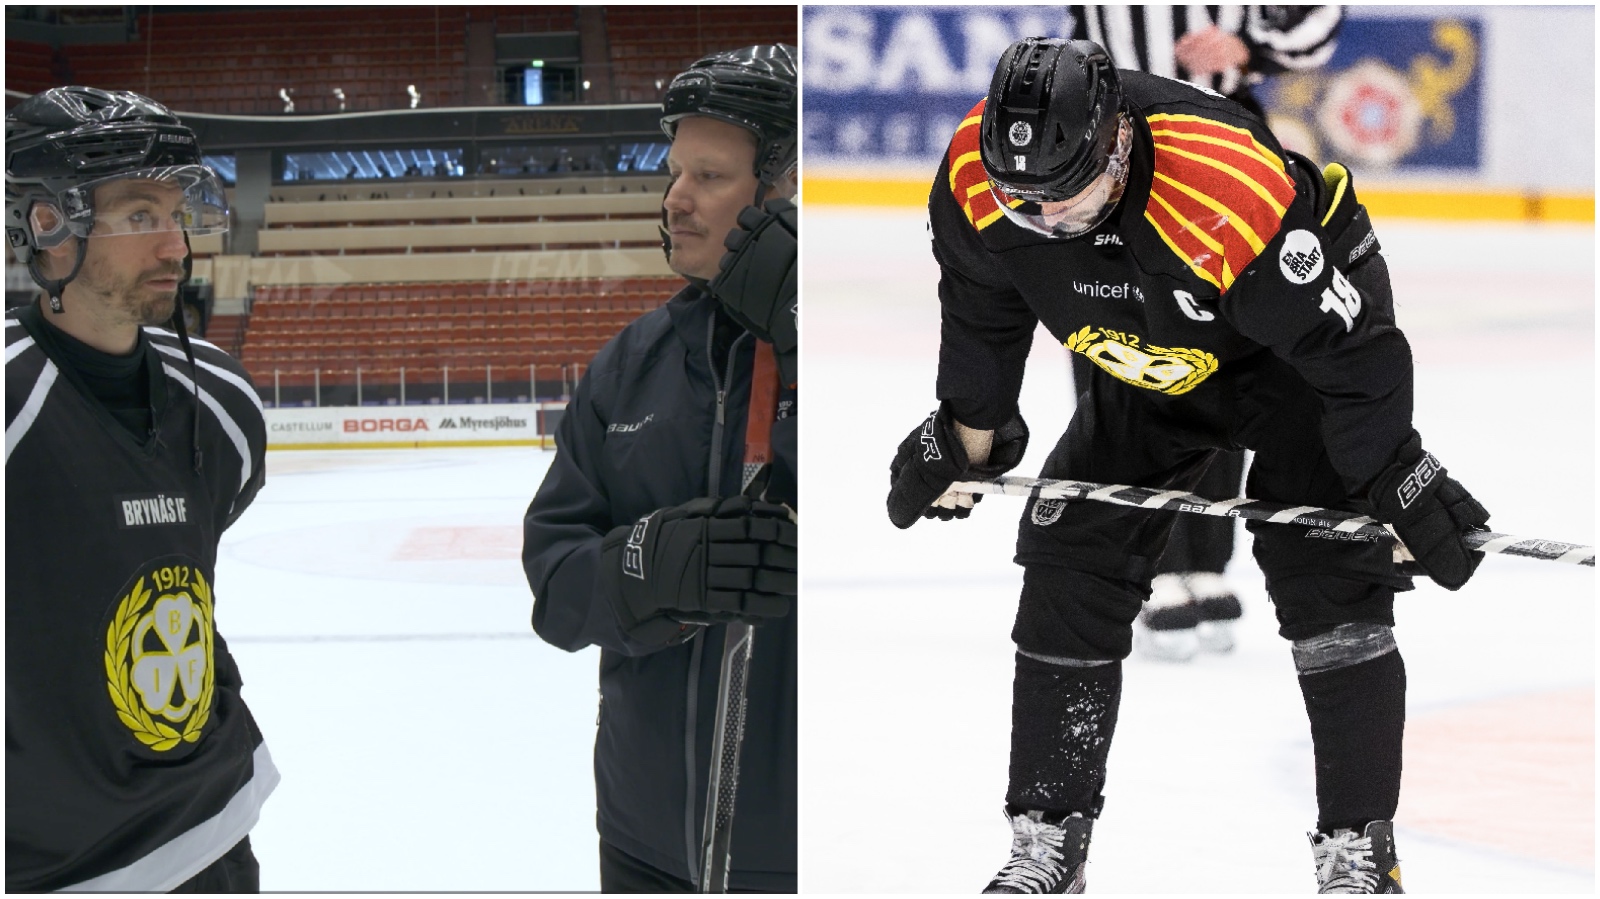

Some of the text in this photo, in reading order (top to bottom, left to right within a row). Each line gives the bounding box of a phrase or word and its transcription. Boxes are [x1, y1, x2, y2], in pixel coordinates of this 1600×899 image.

[1013, 155, 1027, 171] 18
[1281, 250, 1294, 267] EN
[1289, 251, 1308, 275] BRA
[1296, 246, 1321, 281] START
[1073, 280, 1129, 299] unicef
[1319, 265, 1362, 333] 18
[1172, 289, 1215, 322] C
[1098, 326, 1141, 349] 1912
[270, 415, 528, 433] CASTELLUM BORGA Myresjöhus
[122, 494, 187, 526] BRYNÄS IF
[152, 565, 189, 592] 1912
[168, 609, 182, 635] B
[188, 659, 197, 685] F
